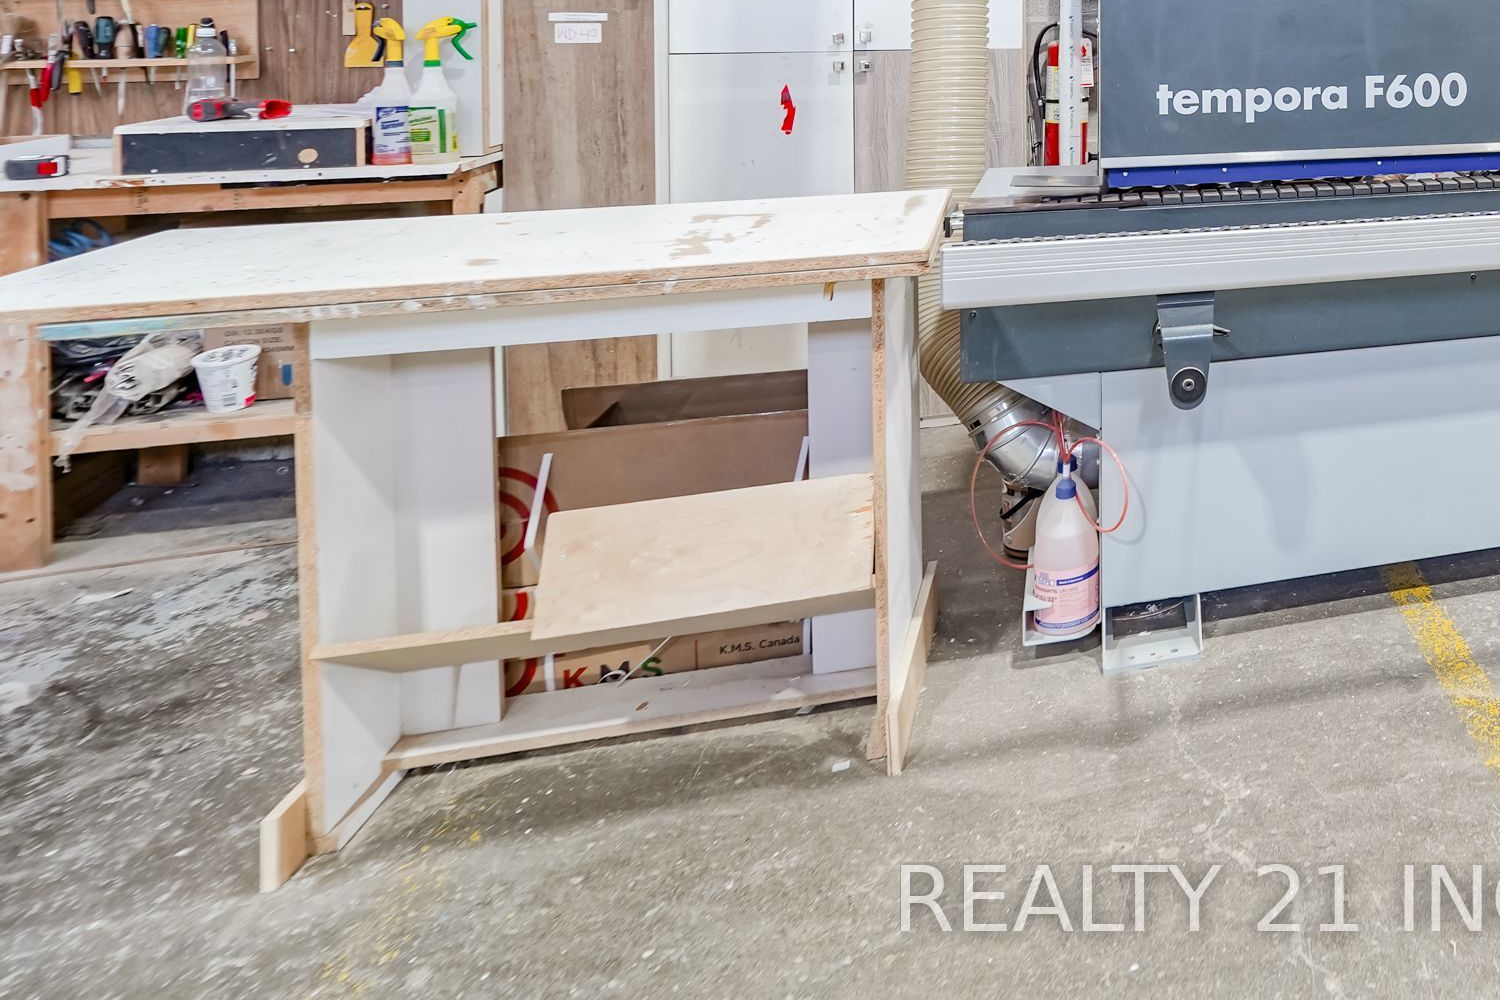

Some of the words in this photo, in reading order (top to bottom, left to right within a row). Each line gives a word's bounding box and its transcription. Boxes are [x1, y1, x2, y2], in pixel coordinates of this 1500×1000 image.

[1156, 84, 1348, 123] tempora
[1365, 72, 1468, 109] F600
[719, 641, 756, 656] K.M.S.
[759, 635, 801, 650] Canada
